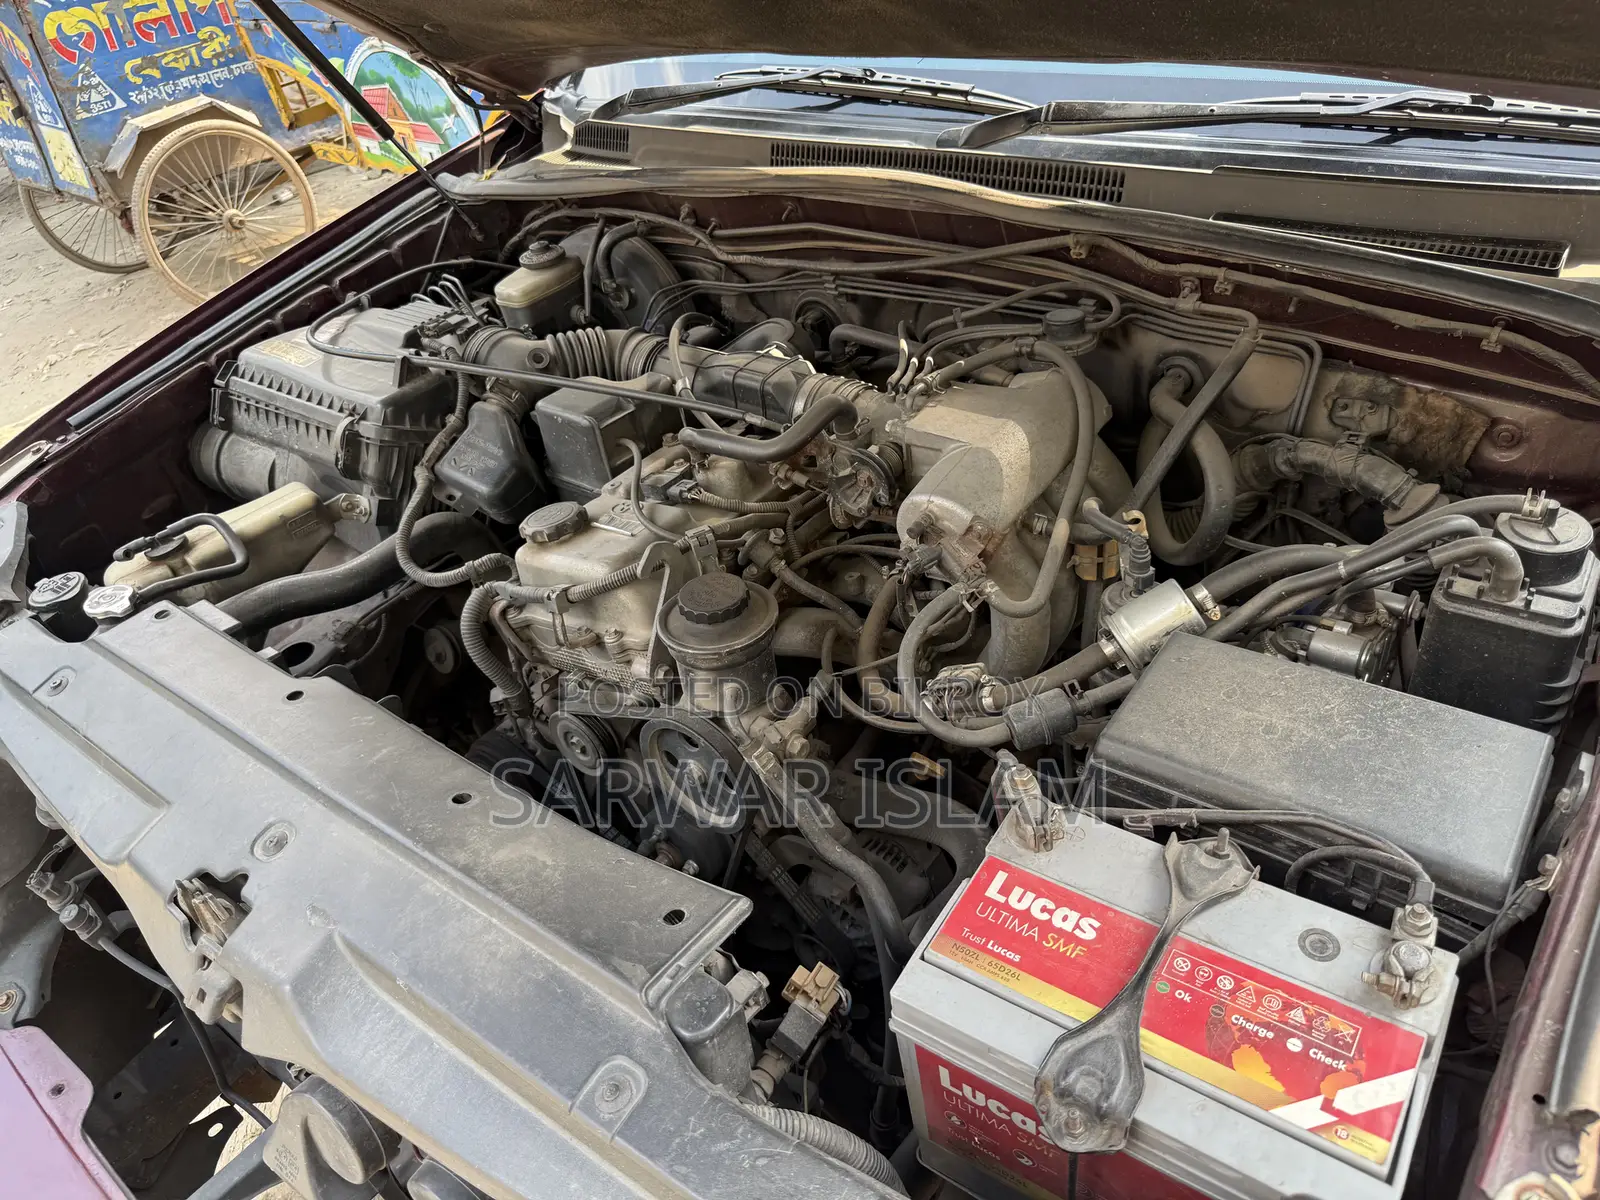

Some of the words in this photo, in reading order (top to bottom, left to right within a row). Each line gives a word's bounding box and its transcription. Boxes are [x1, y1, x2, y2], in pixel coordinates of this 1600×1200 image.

[984, 870, 1101, 941] Lucas
[975, 902, 1039, 942] ULTIMA
[1042, 932, 1088, 959] SMF
[961, 927, 987, 945] Trust
[986, 939, 1022, 963] Lucas
[987, 960, 1021, 981] 65D26L
[1174, 989, 1193, 1003] Ok
[1231, 1014, 1275, 1039] Charge
[1308, 1048, 1347, 1071] Check
[943, 1091, 1012, 1136] ULTIMA
[1336, 1128, 1348, 1139] 18
